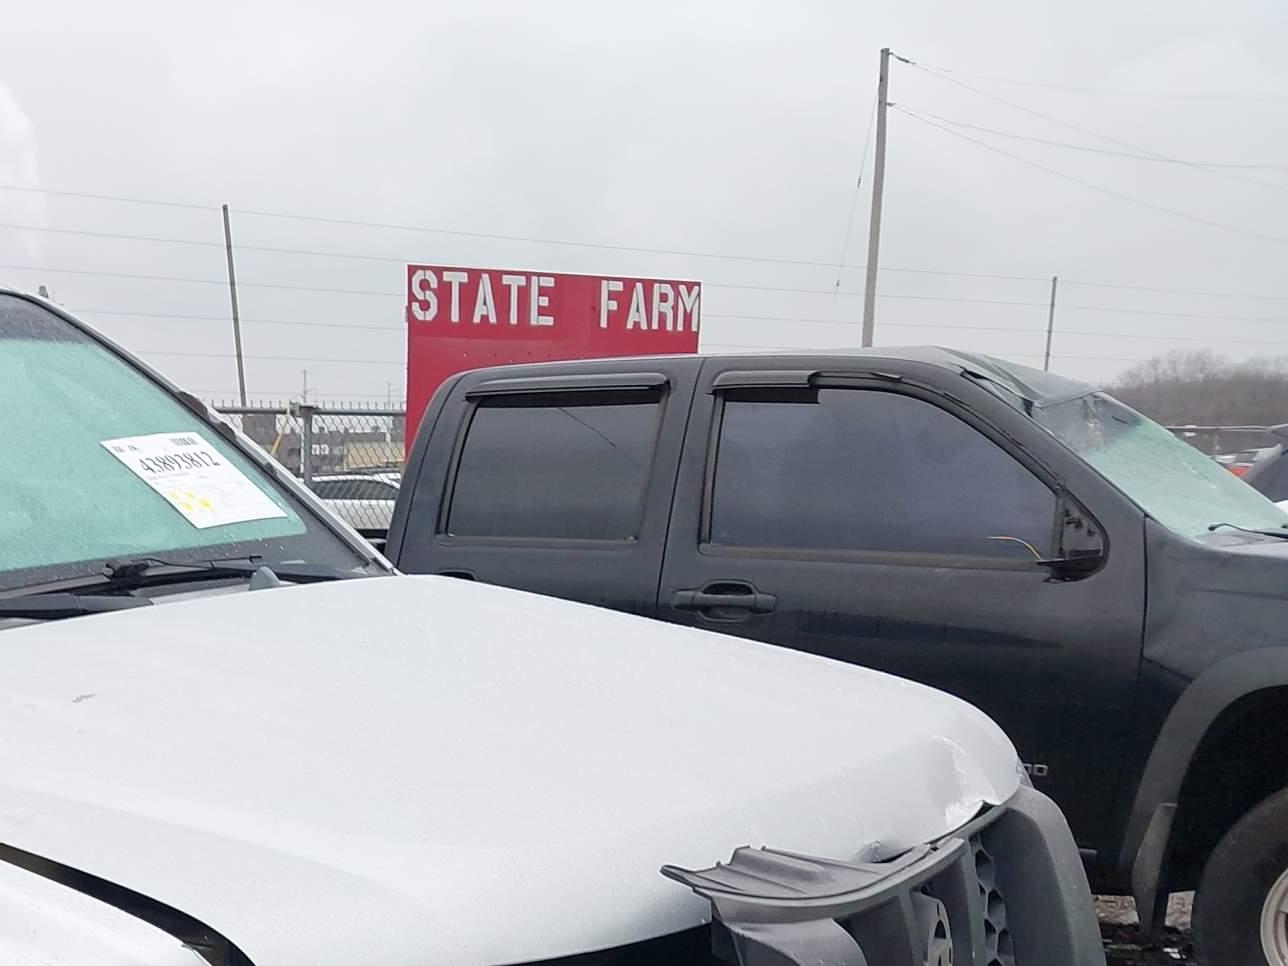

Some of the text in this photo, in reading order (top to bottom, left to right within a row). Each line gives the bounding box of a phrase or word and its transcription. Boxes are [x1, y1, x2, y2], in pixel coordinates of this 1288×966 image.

[411, 269, 701, 332] STATE FARM
[139, 450, 221, 475] 43893812
